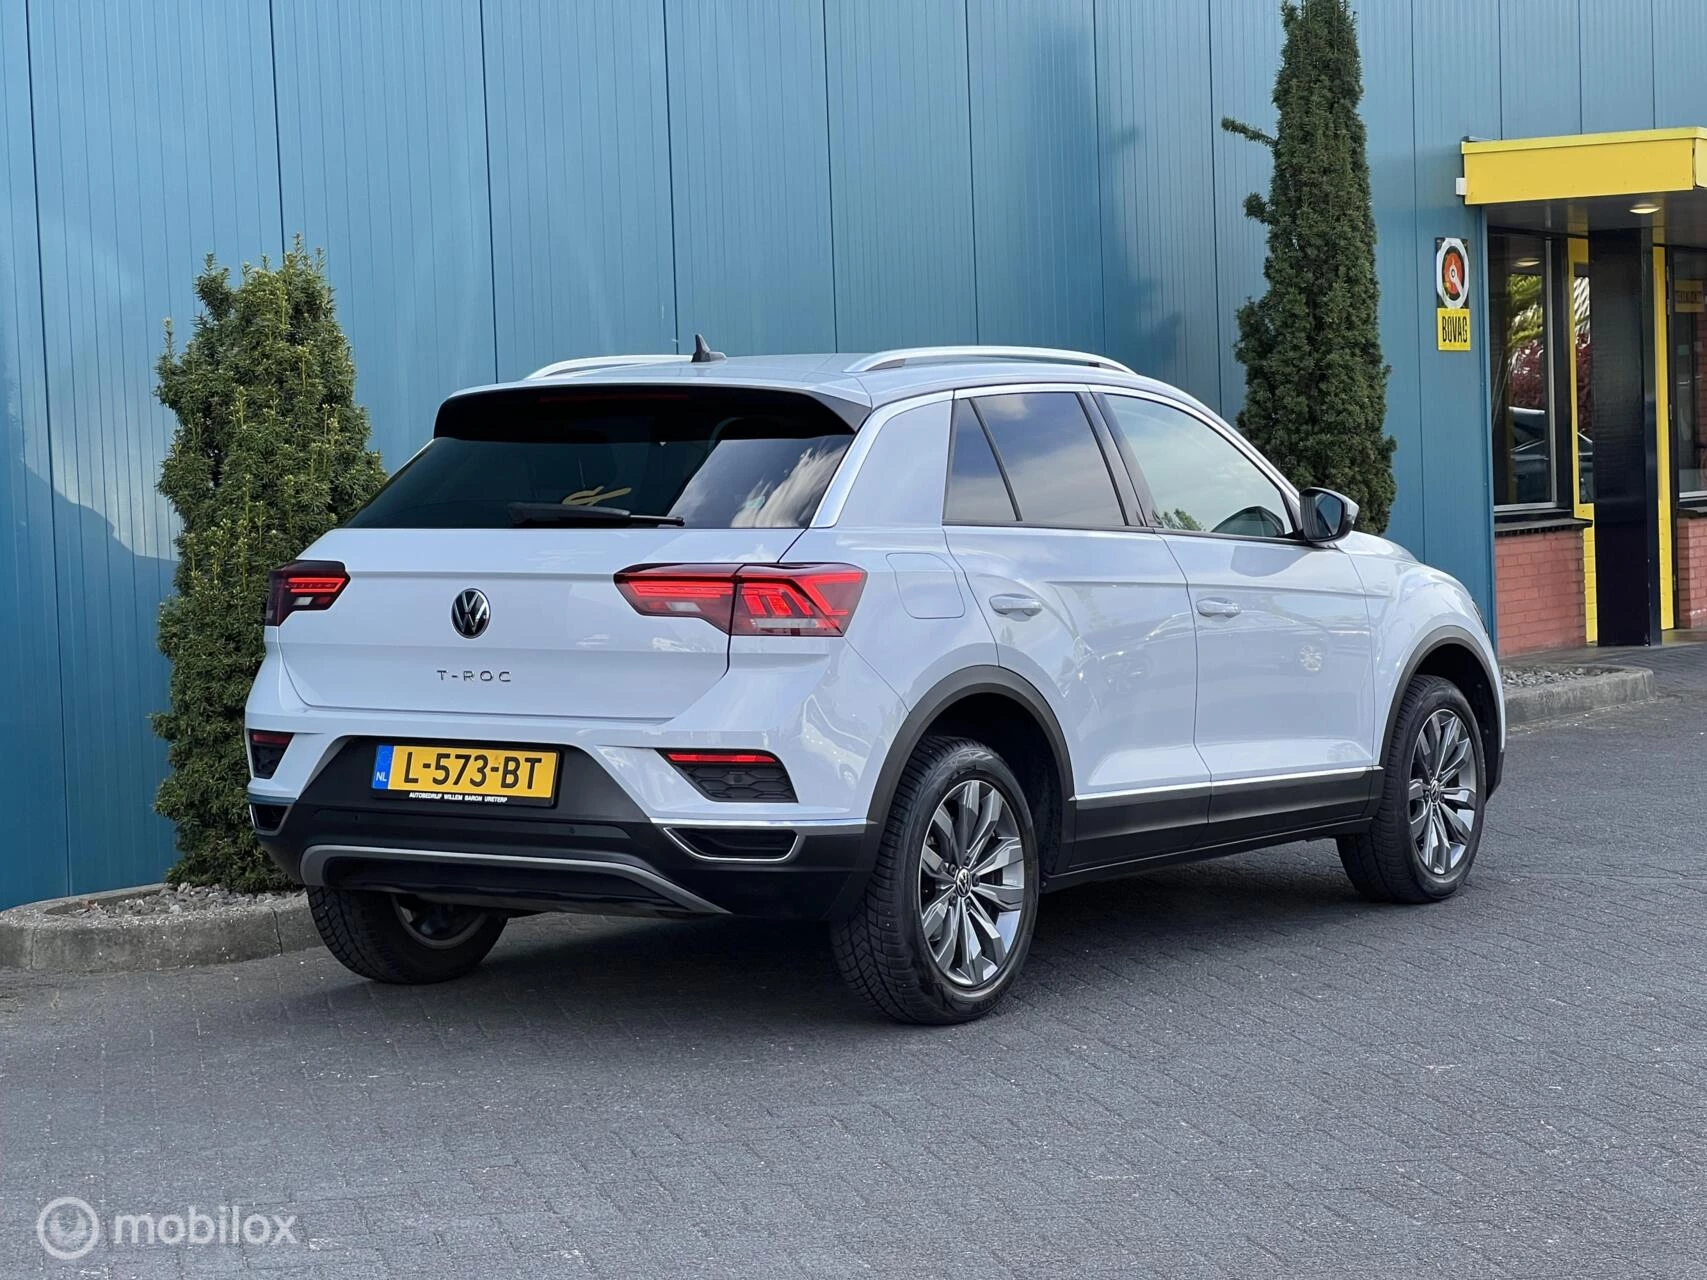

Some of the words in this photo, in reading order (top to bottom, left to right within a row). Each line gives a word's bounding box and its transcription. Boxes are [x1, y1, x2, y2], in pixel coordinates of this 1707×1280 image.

[1441, 316, 1468, 343] BOVAG
[436, 669, 512, 682] T-ROC
[375, 771, 388, 782] NL
[403, 751, 543, 790] L-573-BT
[443, 793, 463, 801] WILLEM
